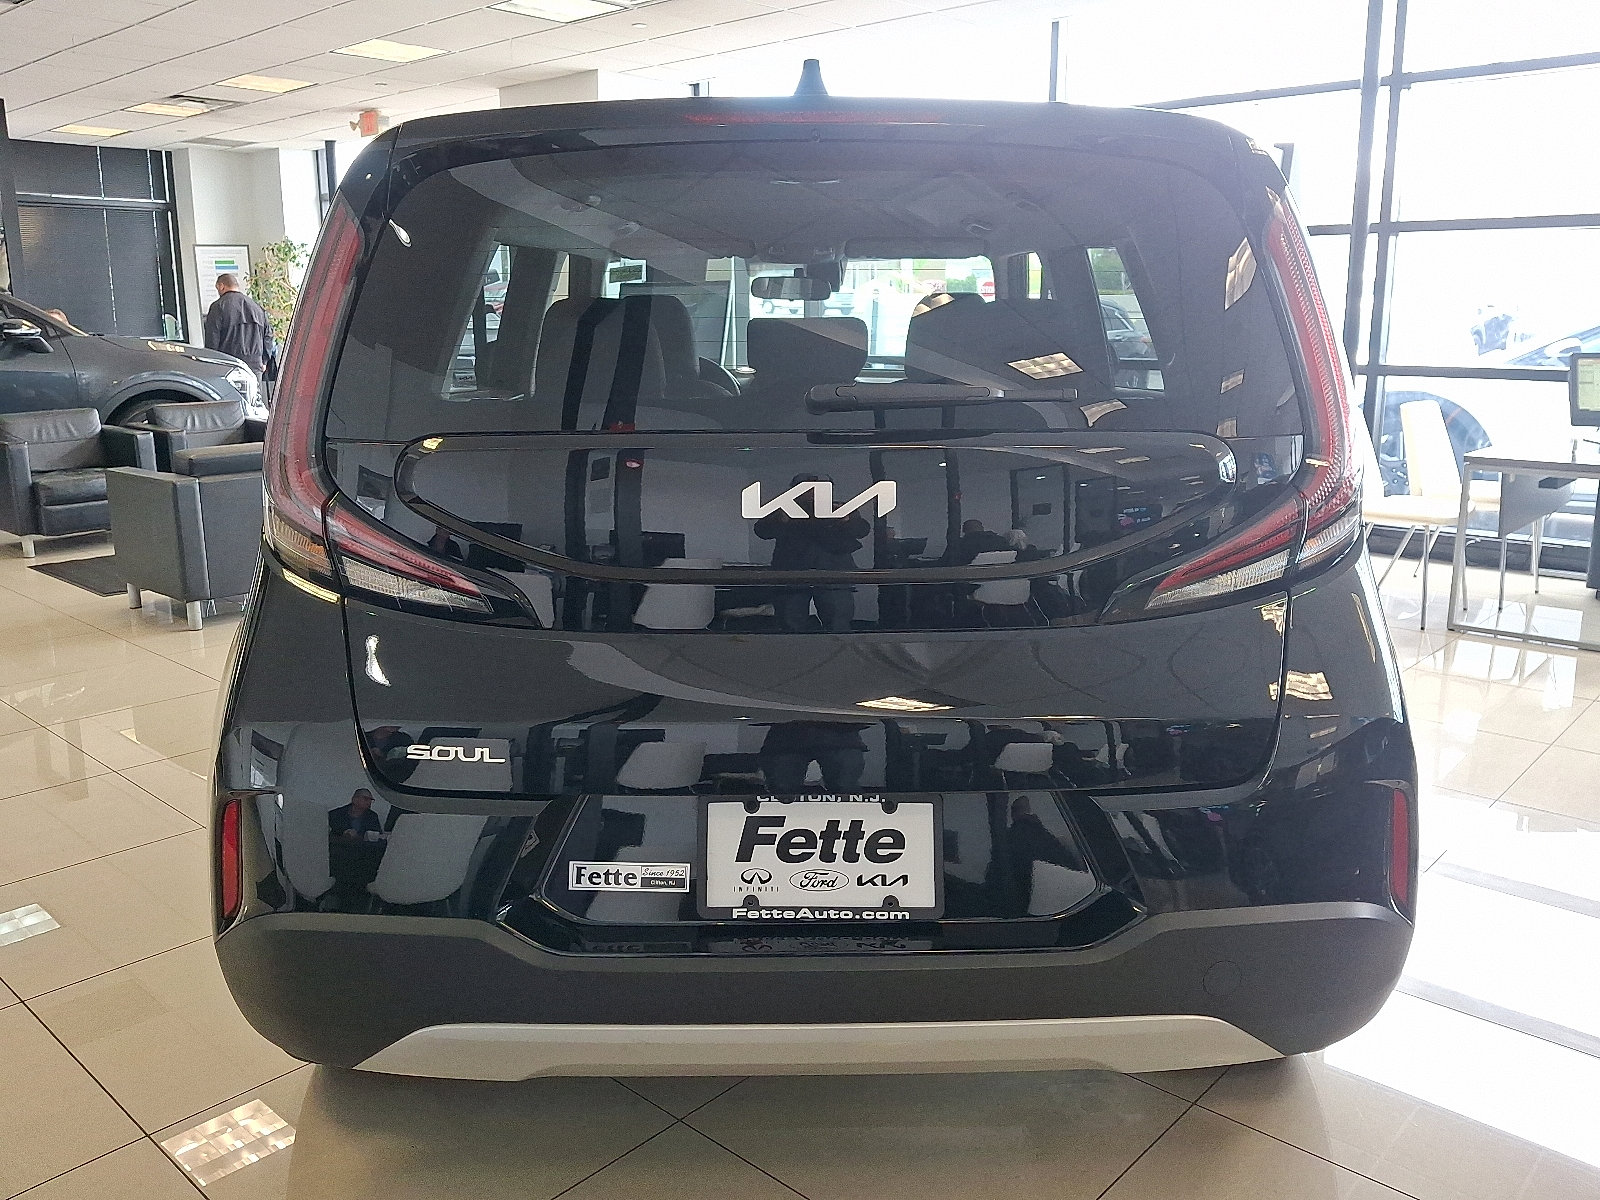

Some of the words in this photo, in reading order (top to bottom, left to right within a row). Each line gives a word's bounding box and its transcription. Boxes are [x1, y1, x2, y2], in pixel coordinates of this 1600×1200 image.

[742, 480, 897, 518] KIA
[406, 744, 506, 763] SOUL
[735, 815, 905, 864] Fette
[575, 866, 638, 886] Fette
[642, 868, 664, 877] Since
[666, 869, 685, 877] 1952
[800, 871, 838, 888] Ford
[856, 874, 909, 887] KIA
[732, 908, 911, 920] FetteAuto.com
